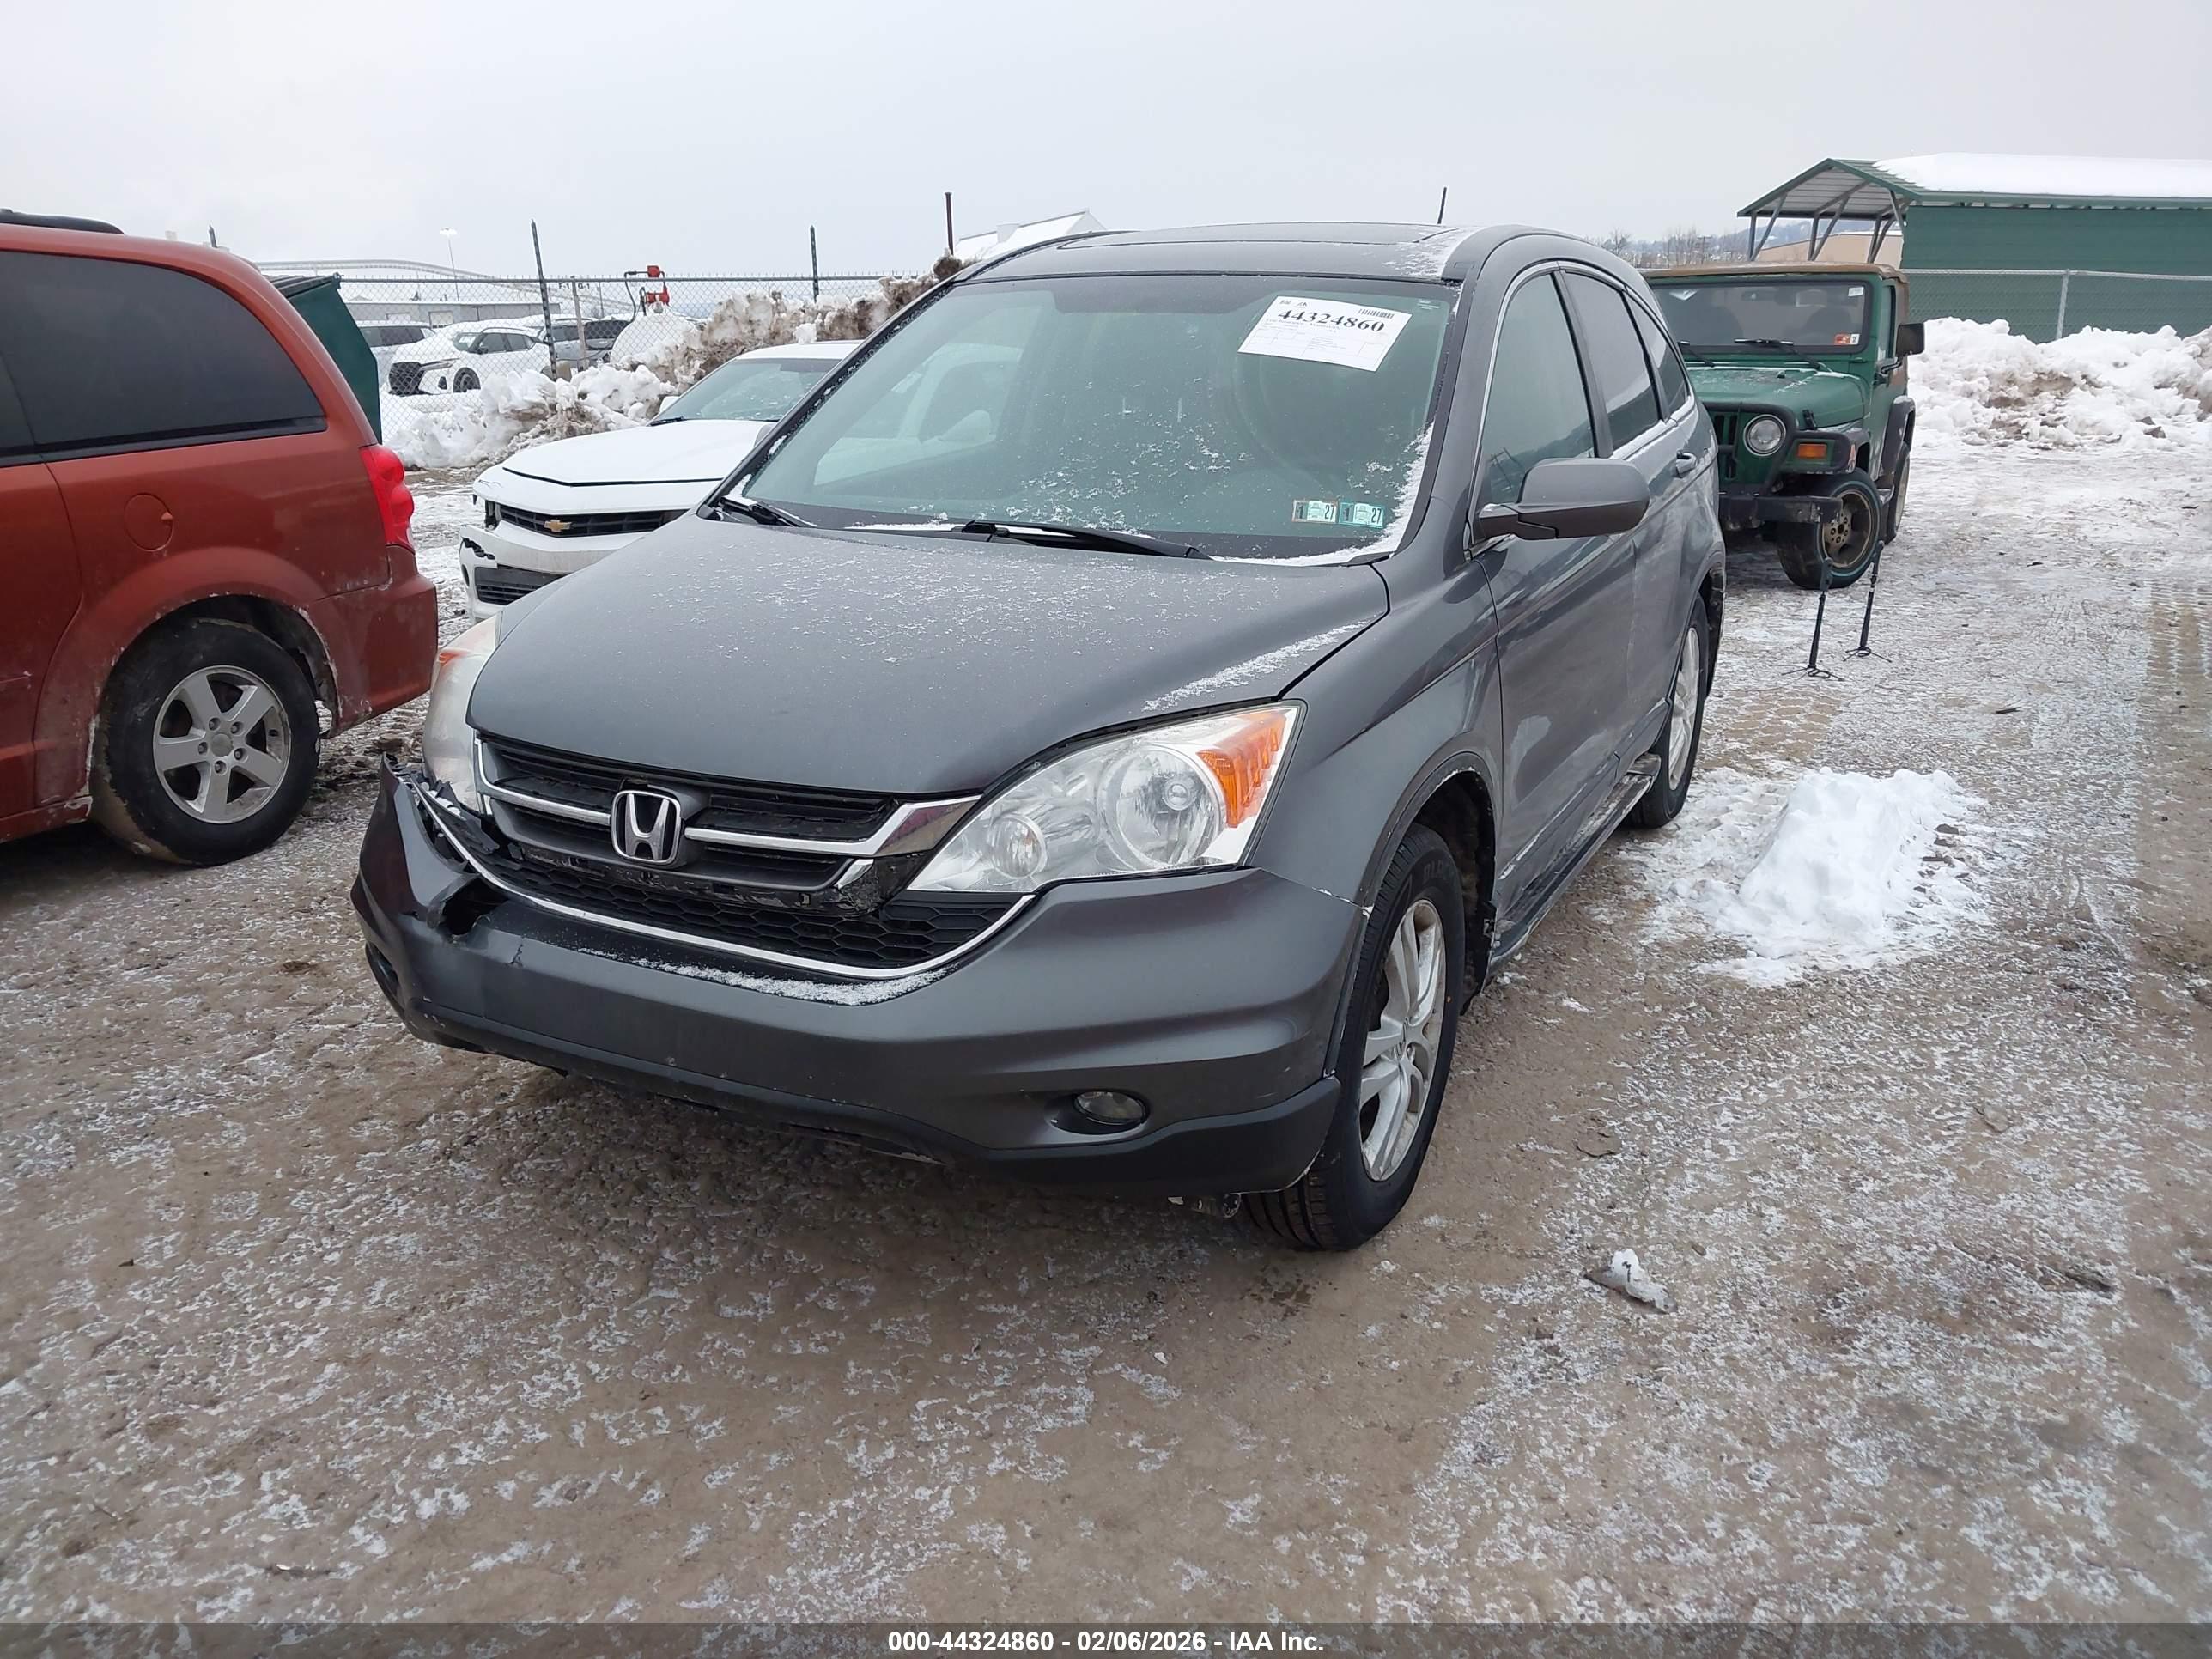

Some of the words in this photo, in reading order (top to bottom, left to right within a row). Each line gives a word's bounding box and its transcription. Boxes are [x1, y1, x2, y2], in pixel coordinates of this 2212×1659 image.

[1278, 310, 1386, 332] 44324860
[1324, 505, 1334, 520] 27
[1371, 507, 1382, 524] 27
